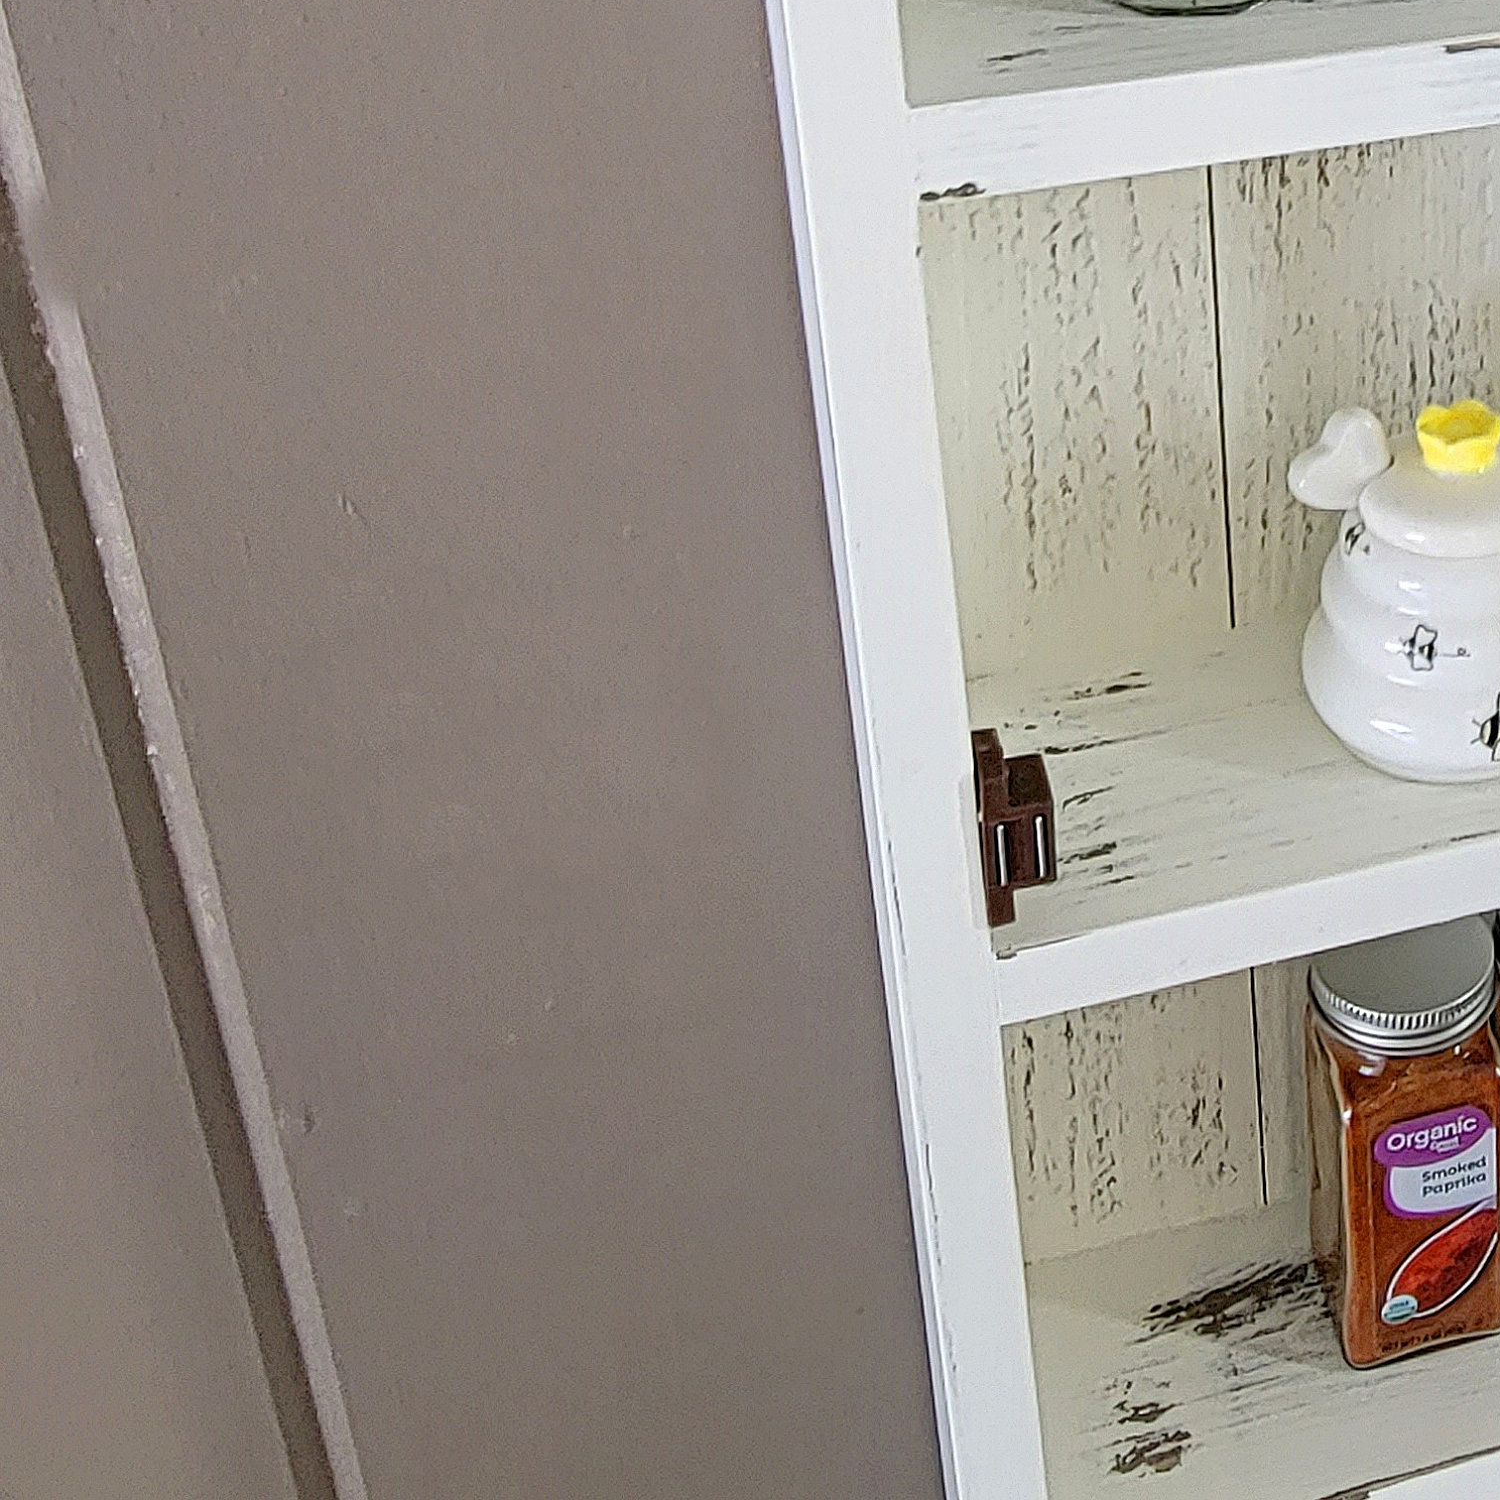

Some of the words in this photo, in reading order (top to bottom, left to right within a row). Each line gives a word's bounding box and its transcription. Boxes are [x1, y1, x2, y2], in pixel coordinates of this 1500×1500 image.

[1386, 1115, 1477, 1151] Organic
[1422, 1155, 1486, 1183] Smoked
[1422, 1172, 1486, 1198] Paprika
